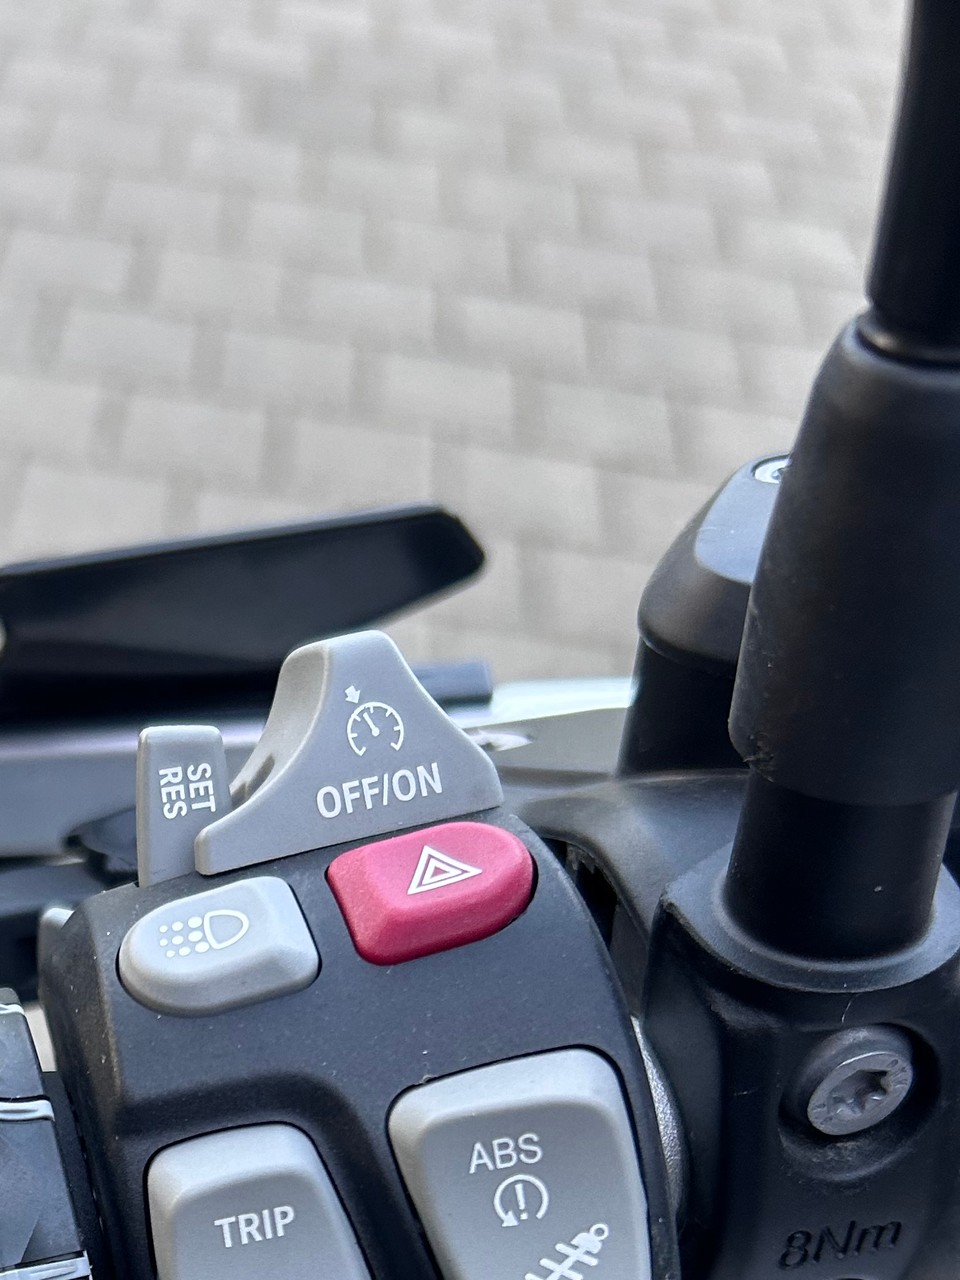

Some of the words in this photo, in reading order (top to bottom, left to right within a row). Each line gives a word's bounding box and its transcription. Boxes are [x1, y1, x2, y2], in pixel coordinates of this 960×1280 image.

[158, 766, 187, 820] RES
[187, 763, 216, 812] SET
[316, 762, 443, 818] OFF/ON
[469, 1133, 542, 1174] ABS
[214, 1205, 295, 1248] TRIP
[778, 1220, 902, 1271] 8Nm
